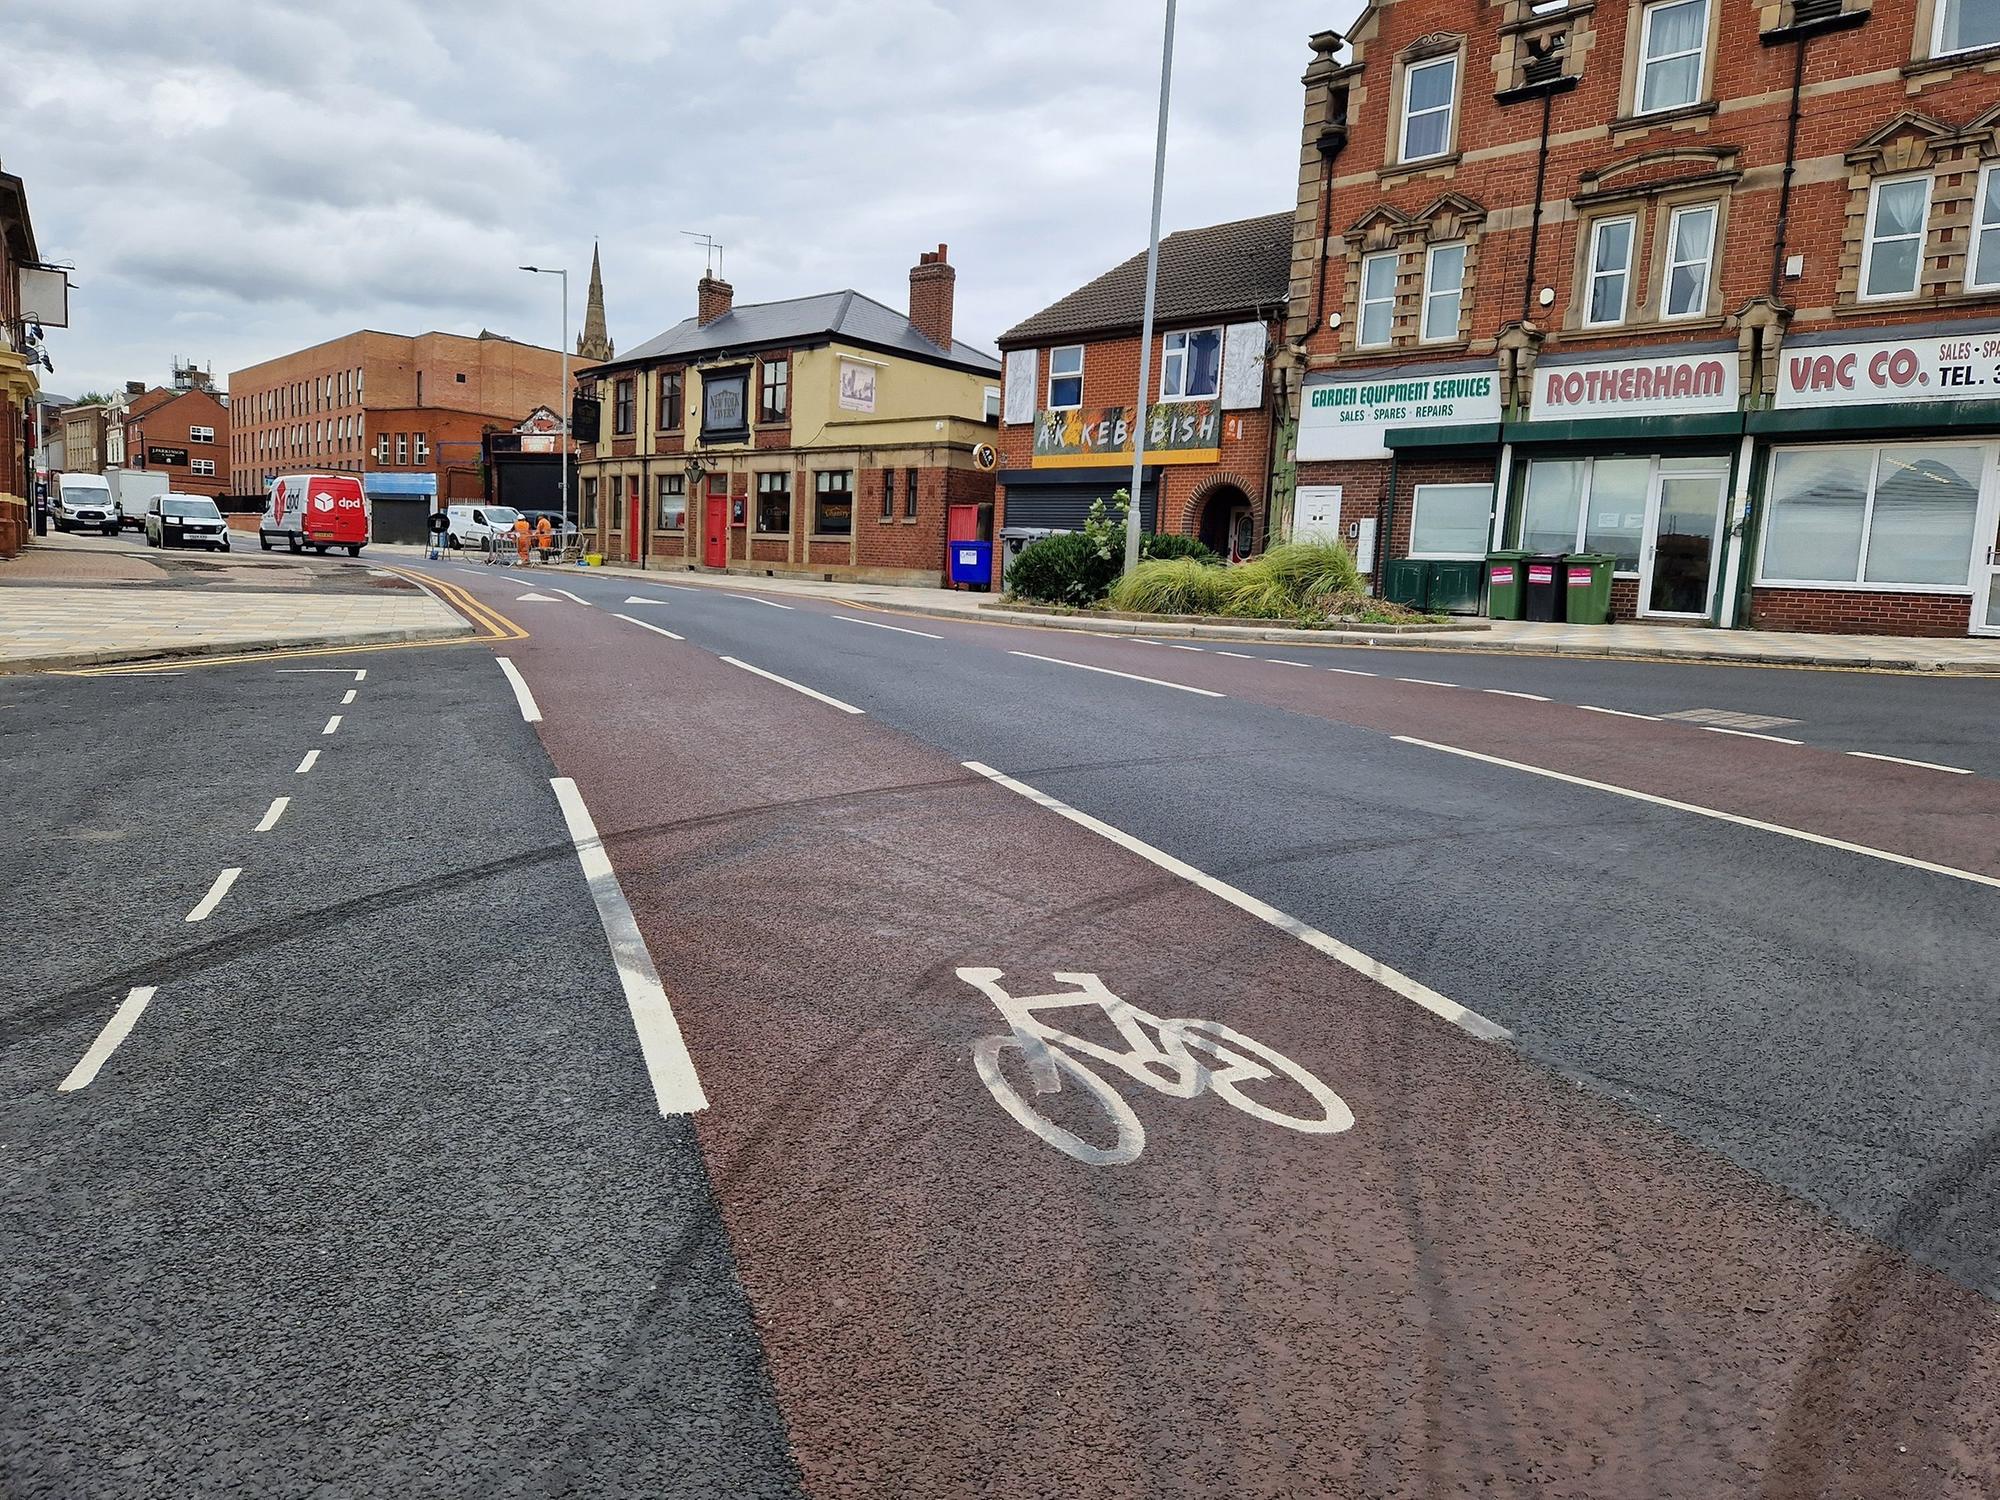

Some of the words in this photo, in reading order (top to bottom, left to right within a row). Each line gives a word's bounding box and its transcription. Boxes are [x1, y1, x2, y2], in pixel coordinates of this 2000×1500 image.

[1939, 342, 1971, 361] SALES
[1547, 361, 1726, 406] ROTHERHAM
[1790, 353, 1857, 393] VAC
[1868, 348, 1930, 388] CO.
[1939, 365, 1985, 387] TEL.
[1311, 388, 1357, 408] GARDEN
[1360, 382, 1430, 408] EQUIPMENT
[1432, 377, 1491, 400] SERVICES
[1340, 410, 1365, 422] SALES
[1374, 407, 1407, 420] SPARES
[1415, 404, 1454, 418] REPAIRS
[1037, 423, 1068, 450] AK
[1081, 415, 1215, 447] KEBBISH
[338, 497, 361, 510] dpd
